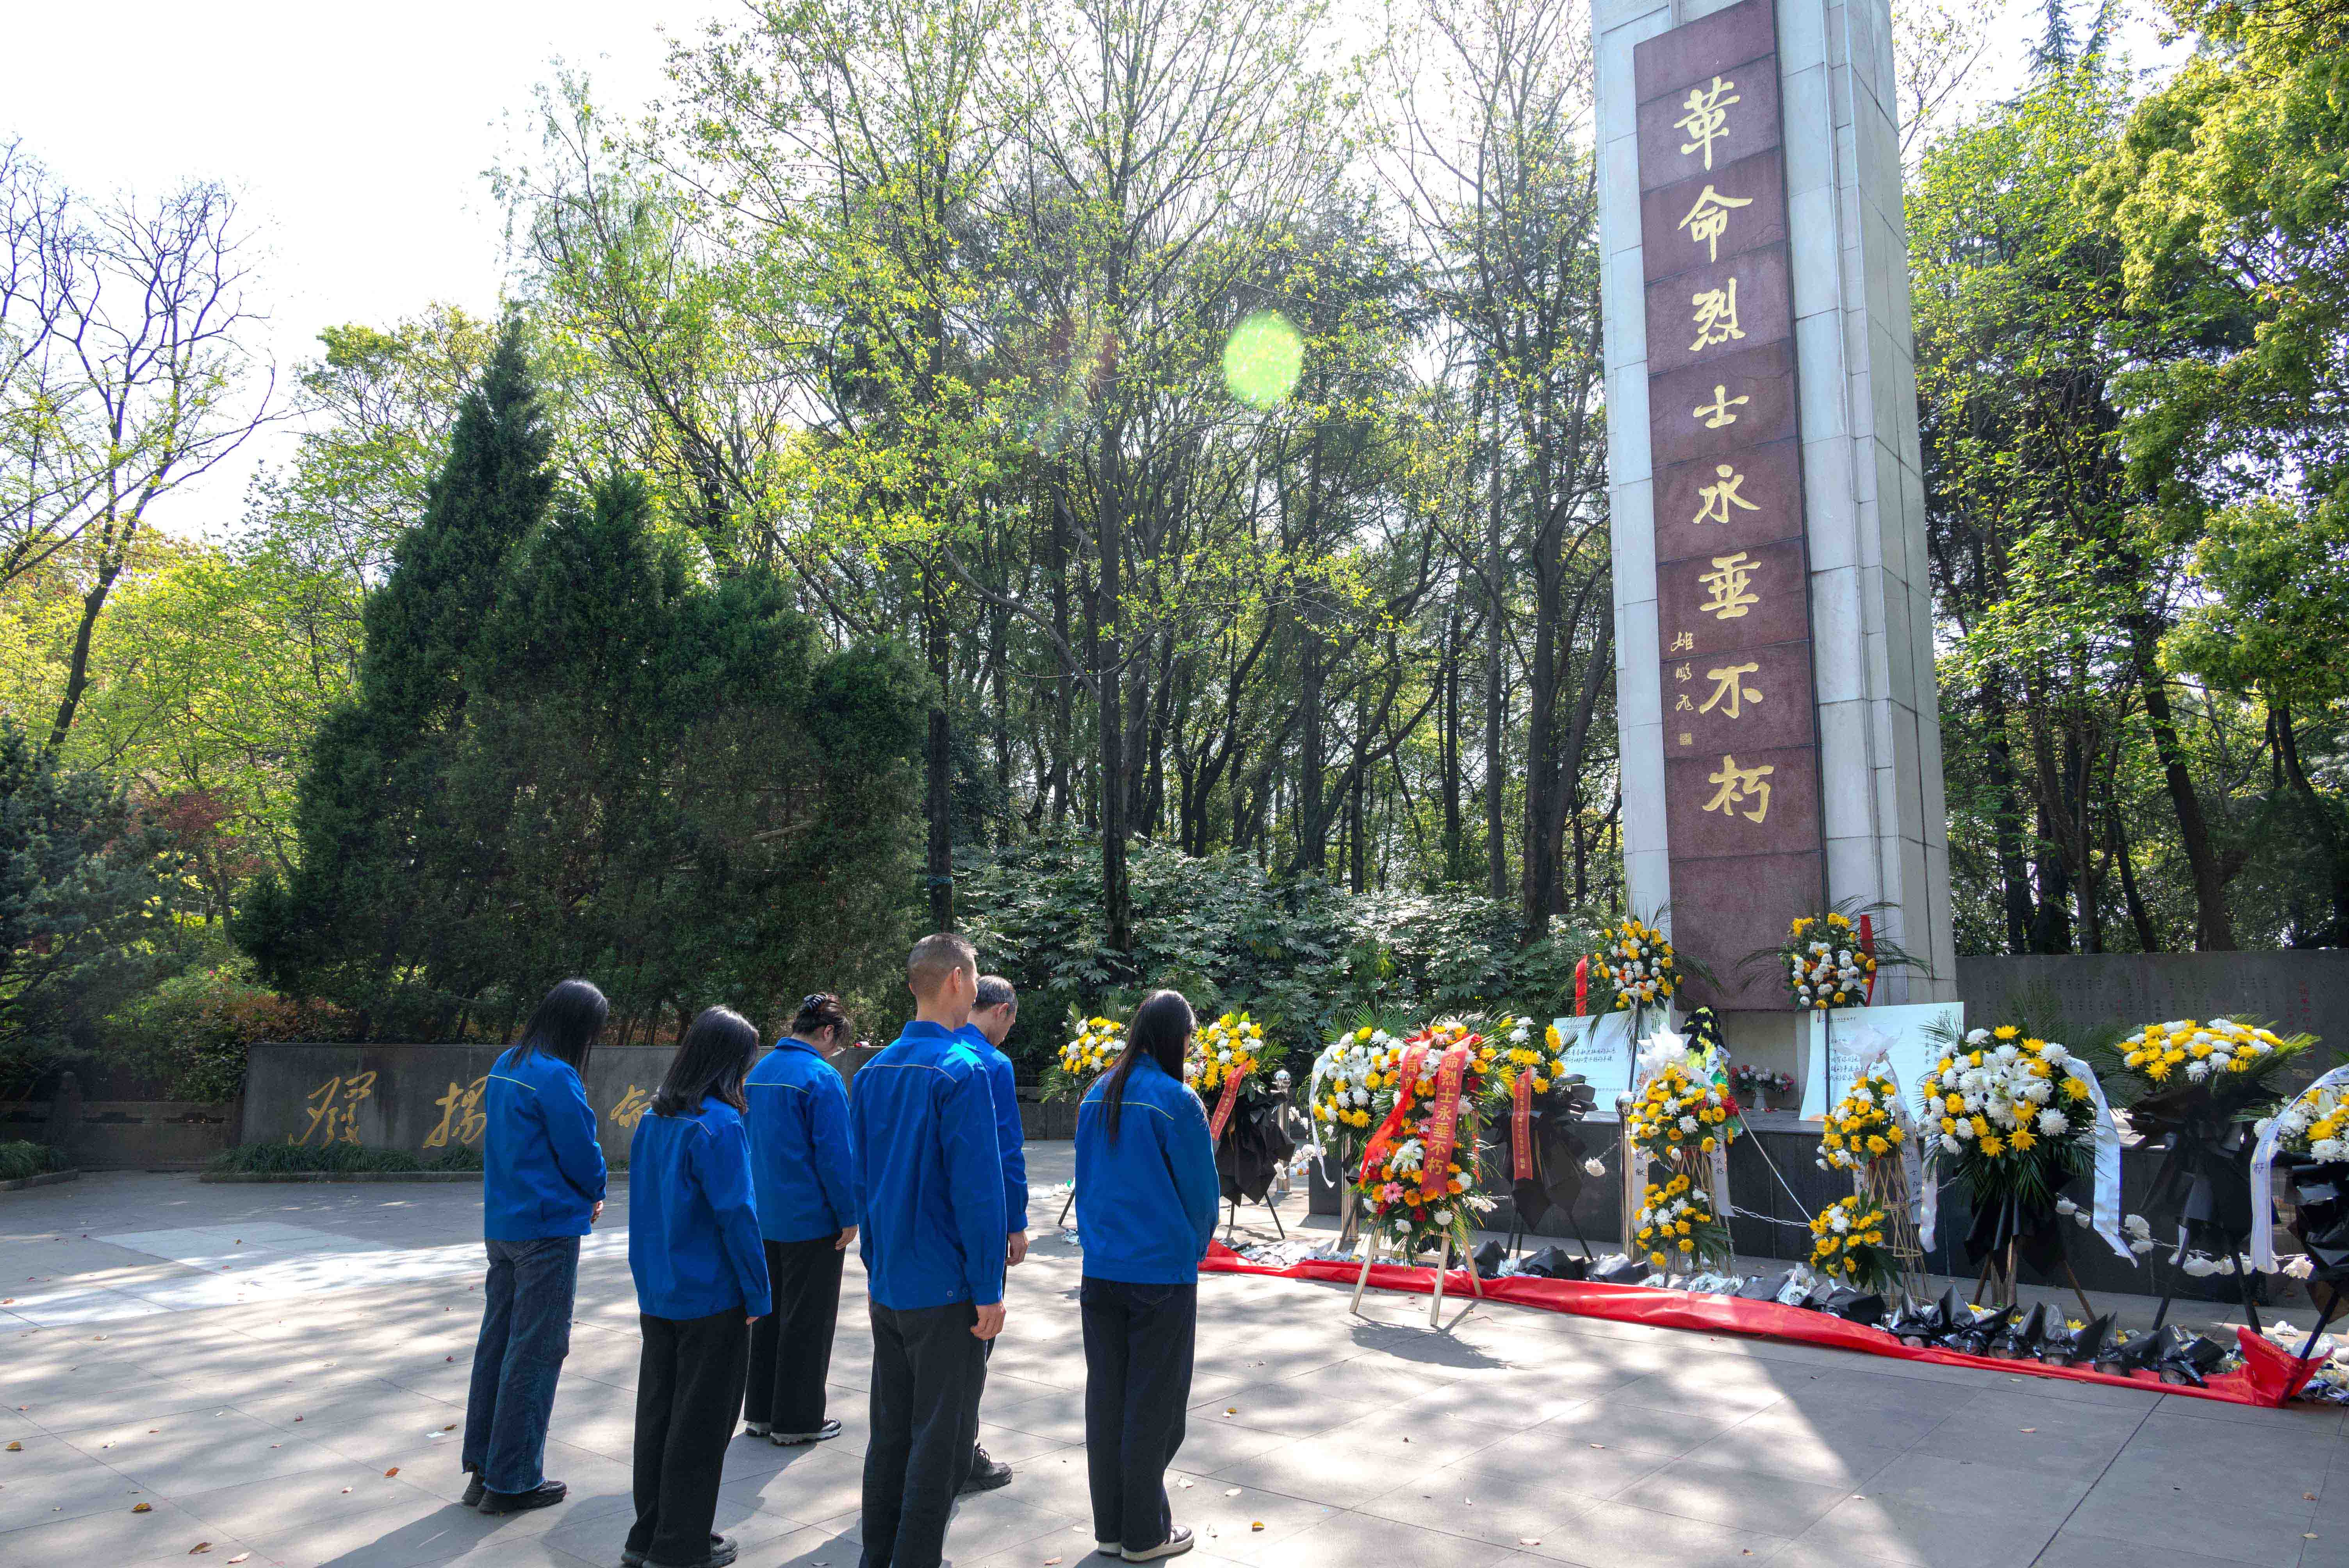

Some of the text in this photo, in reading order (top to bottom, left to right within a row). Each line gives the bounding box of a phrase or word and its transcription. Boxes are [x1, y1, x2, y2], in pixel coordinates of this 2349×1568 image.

[1673, 77, 1774, 823] 革命烈士永垂不朽
